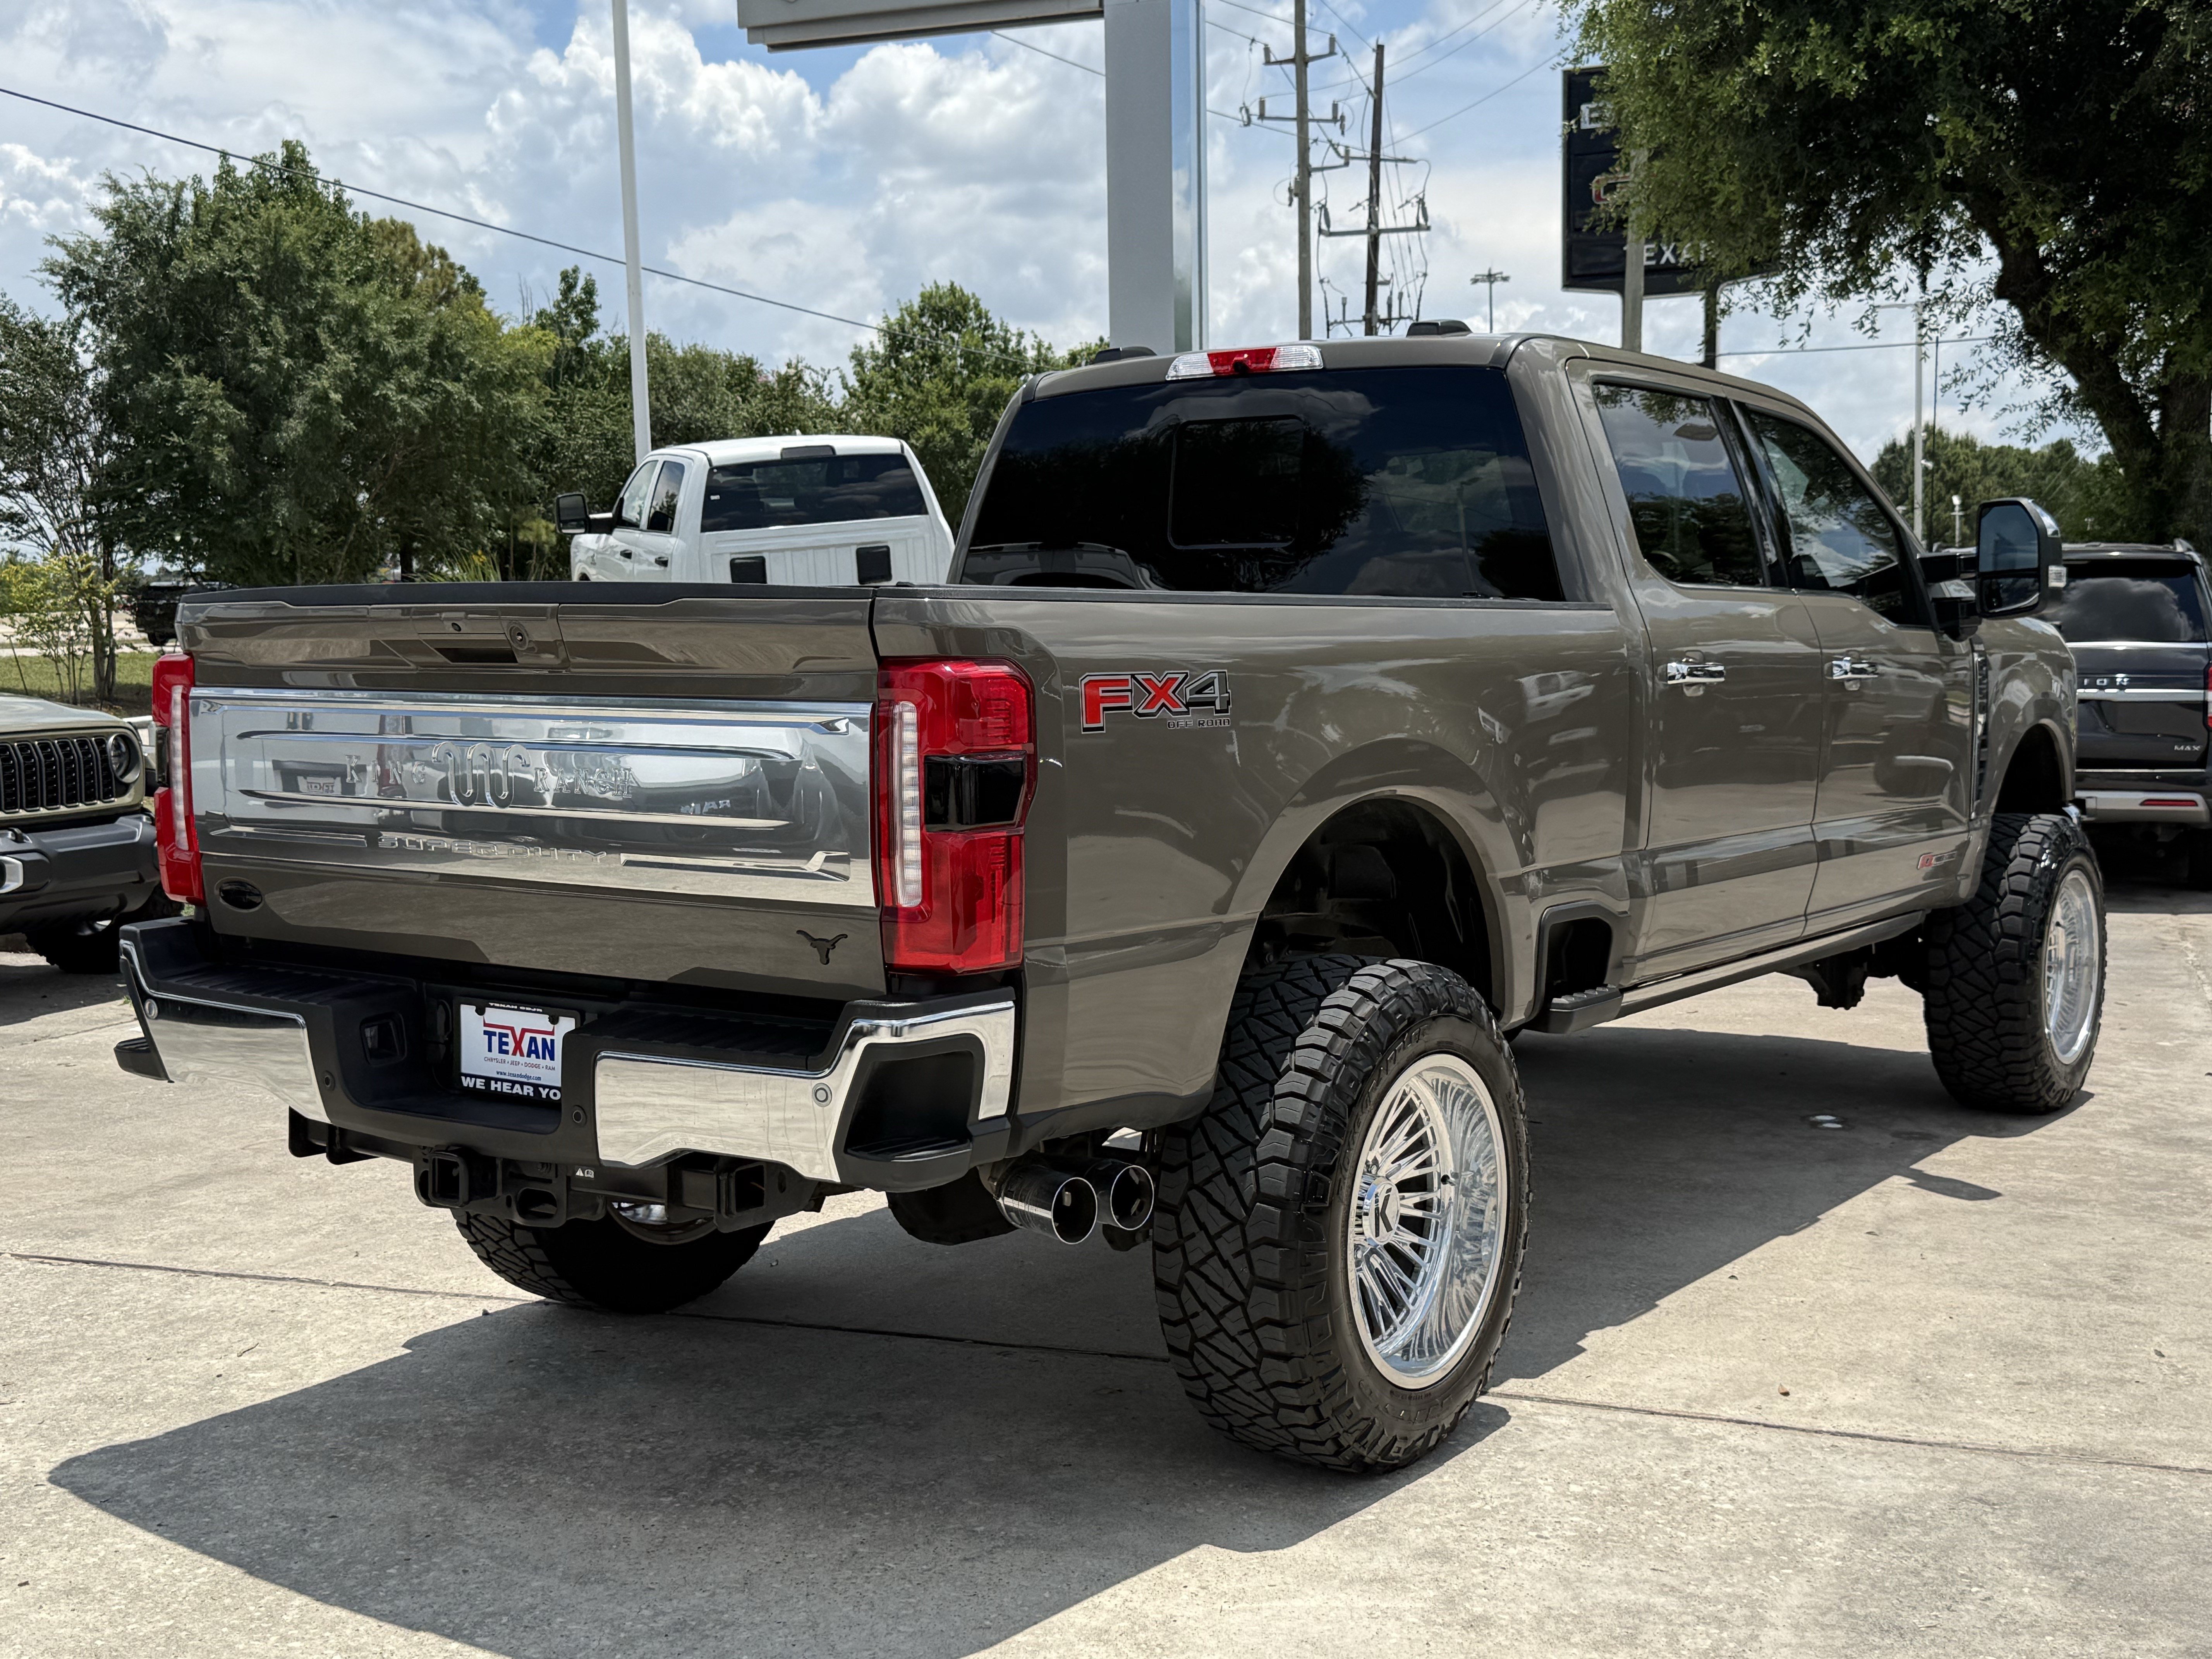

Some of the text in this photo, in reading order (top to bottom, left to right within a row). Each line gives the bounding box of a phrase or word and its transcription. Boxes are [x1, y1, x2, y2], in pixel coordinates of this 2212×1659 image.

[1079, 670, 1231, 734] FX4
[1167, 718, 1230, 729] OFF ROAD
[346, 755, 632, 798] KING RANCH
[378, 835, 607, 863] SUPER DUTY
[483, 1025, 555, 1061] TEXAN
[461, 1076, 561, 1100] WE HEAR YO
